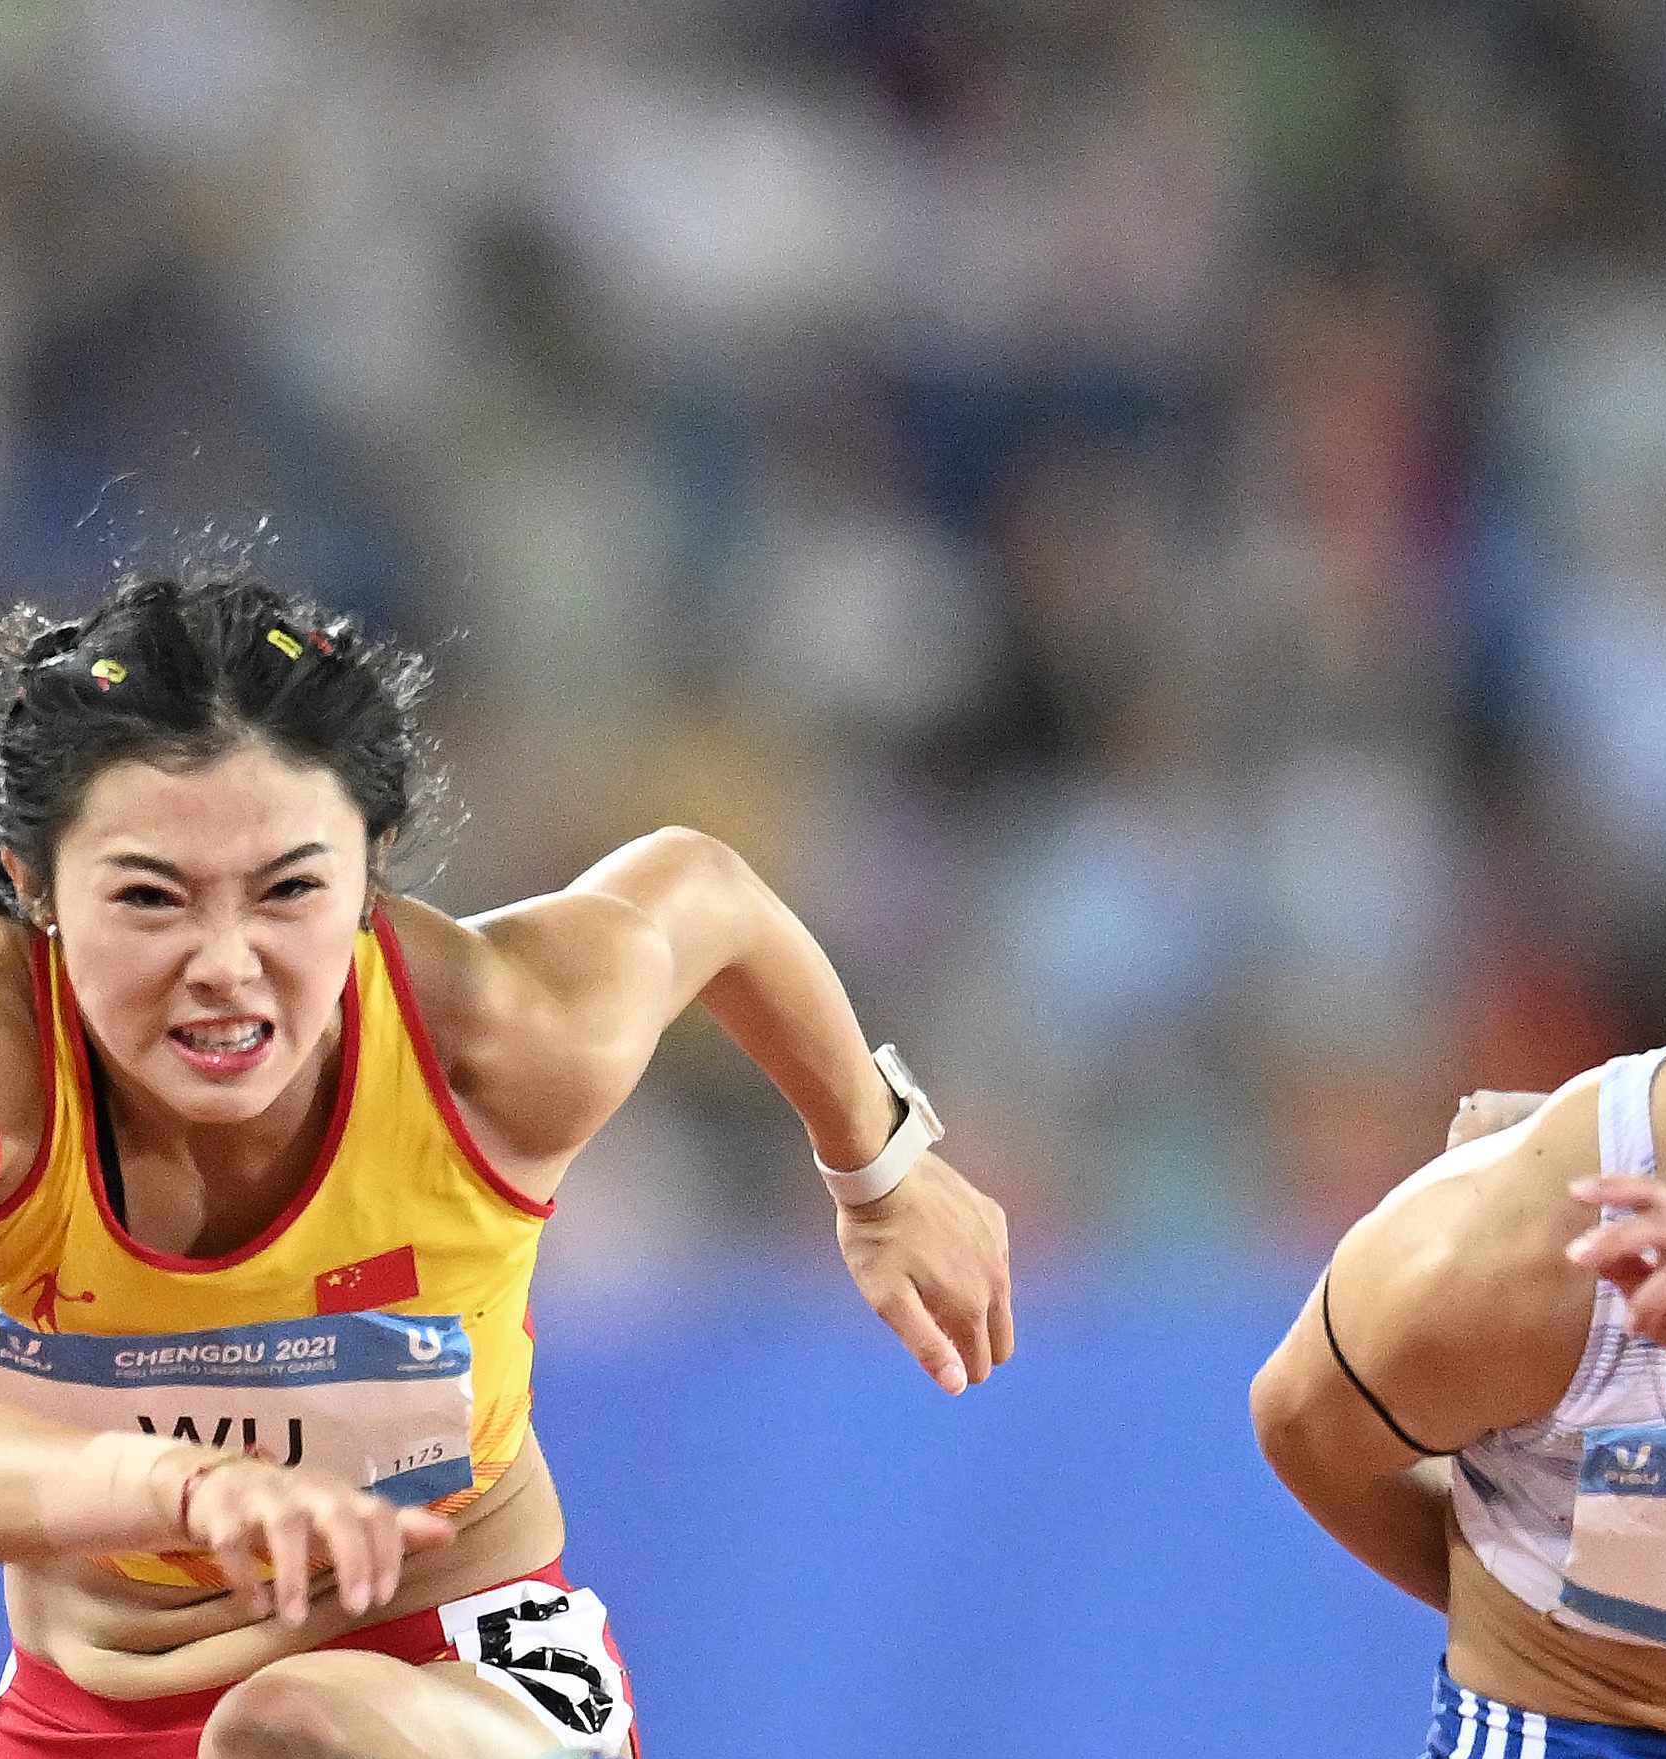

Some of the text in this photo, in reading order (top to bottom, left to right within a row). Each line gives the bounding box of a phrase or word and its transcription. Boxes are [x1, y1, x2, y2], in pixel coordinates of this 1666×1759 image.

[114, 1336, 337, 1367] CHENGDU 2021
[393, 1442, 443, 1473] 1175
